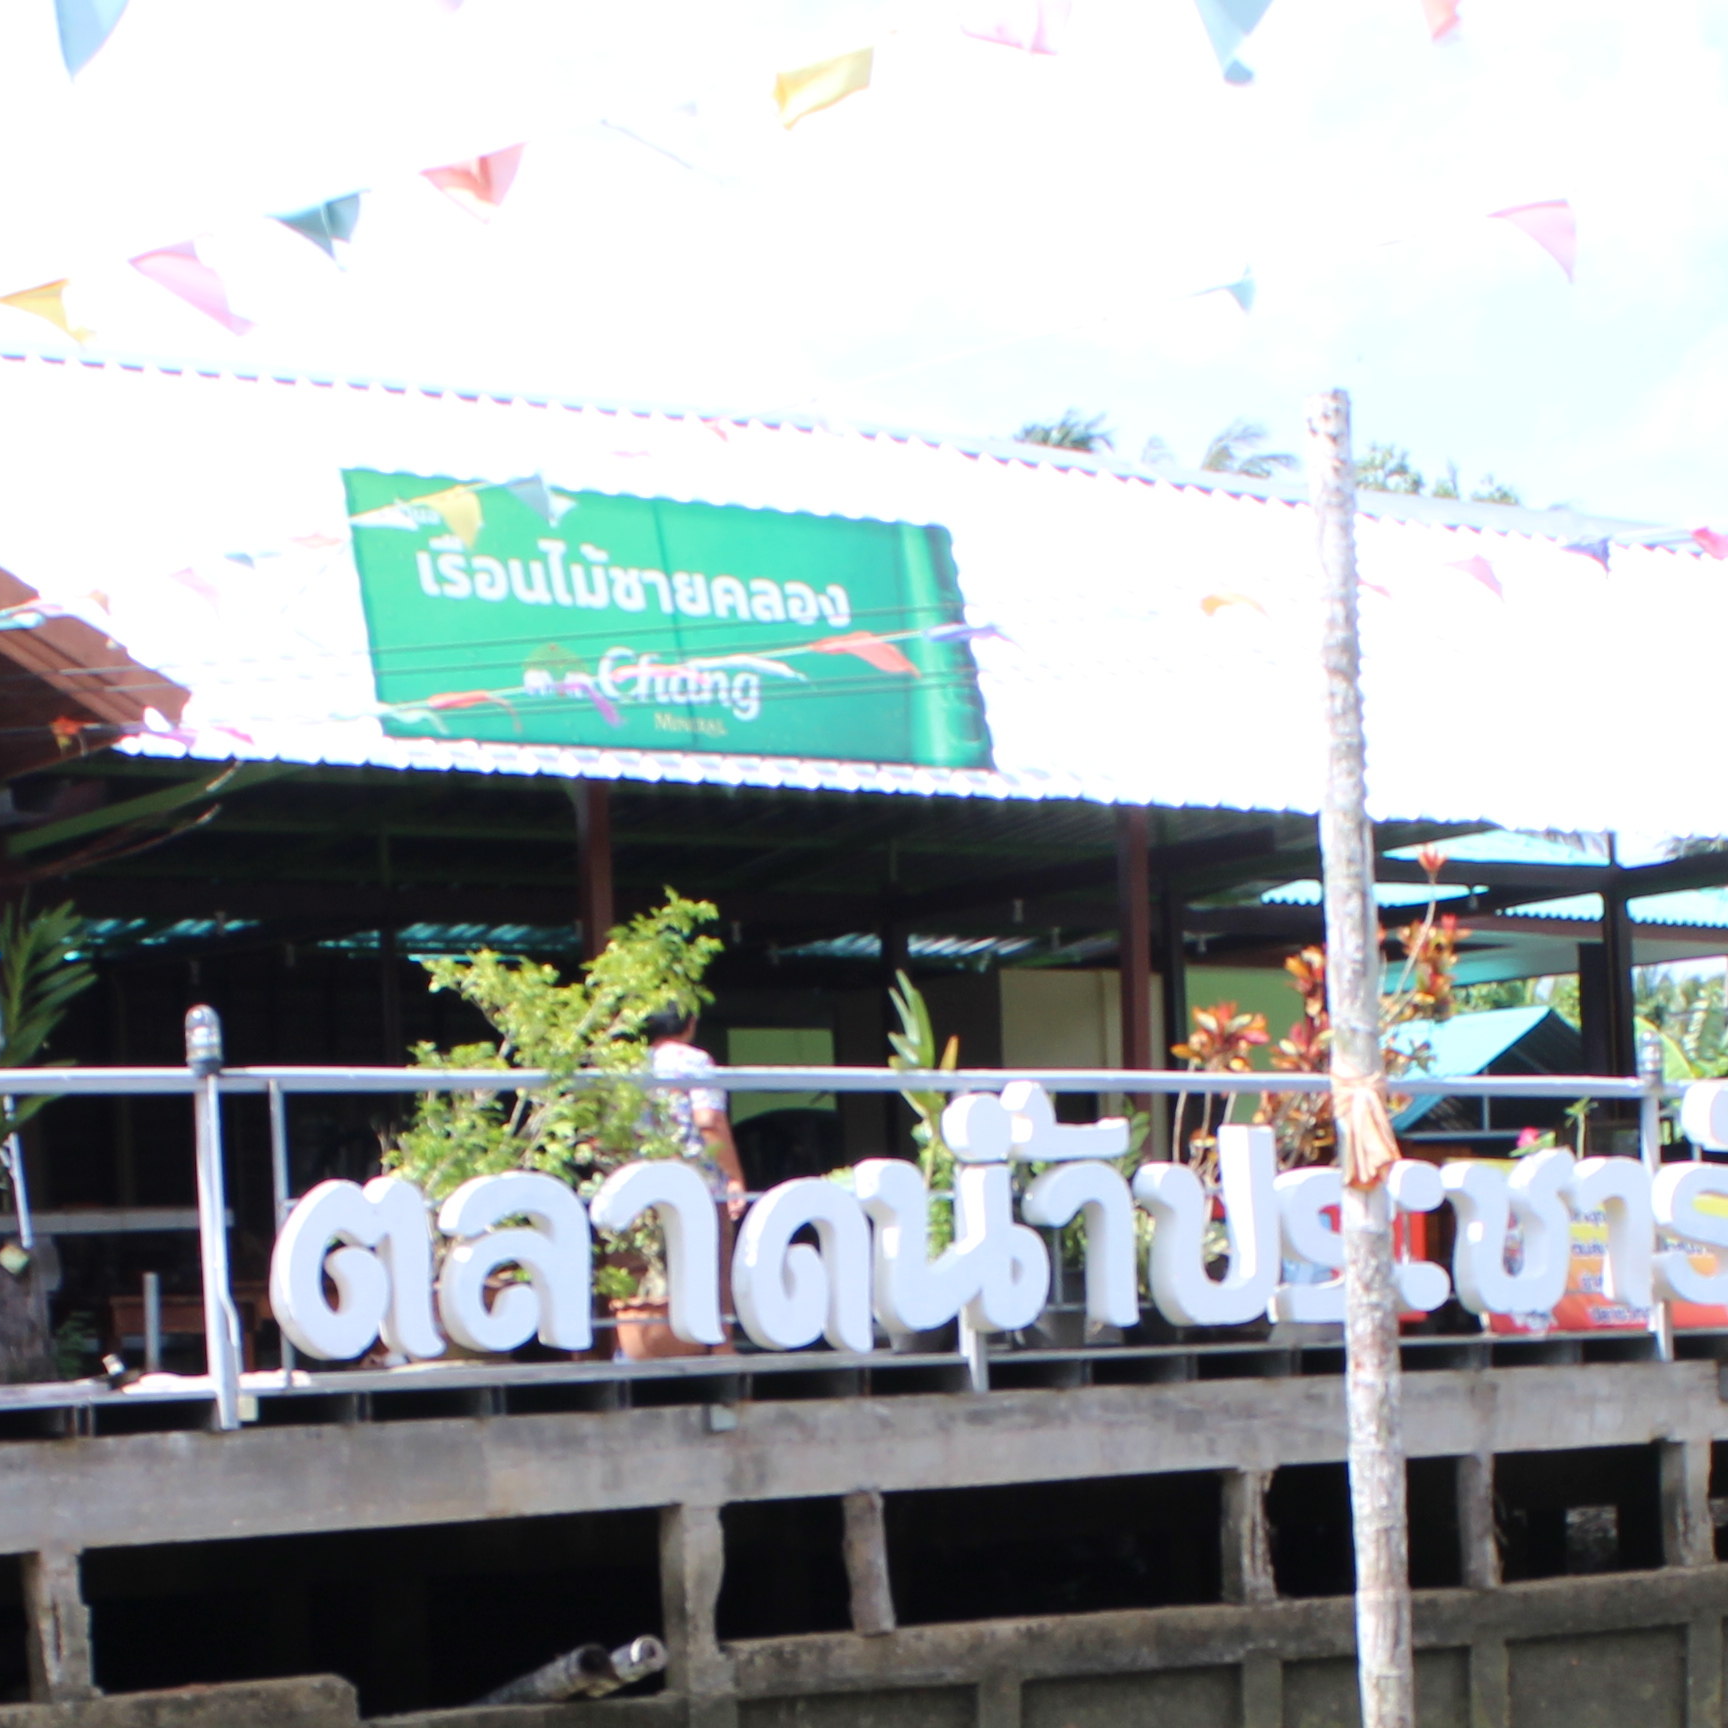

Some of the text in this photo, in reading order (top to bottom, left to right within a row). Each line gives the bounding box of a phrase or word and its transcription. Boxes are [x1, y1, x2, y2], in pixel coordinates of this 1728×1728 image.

[416, 534, 851, 627] เรือนไม้ชายคลอง
[597, 646, 762, 722] Chang
